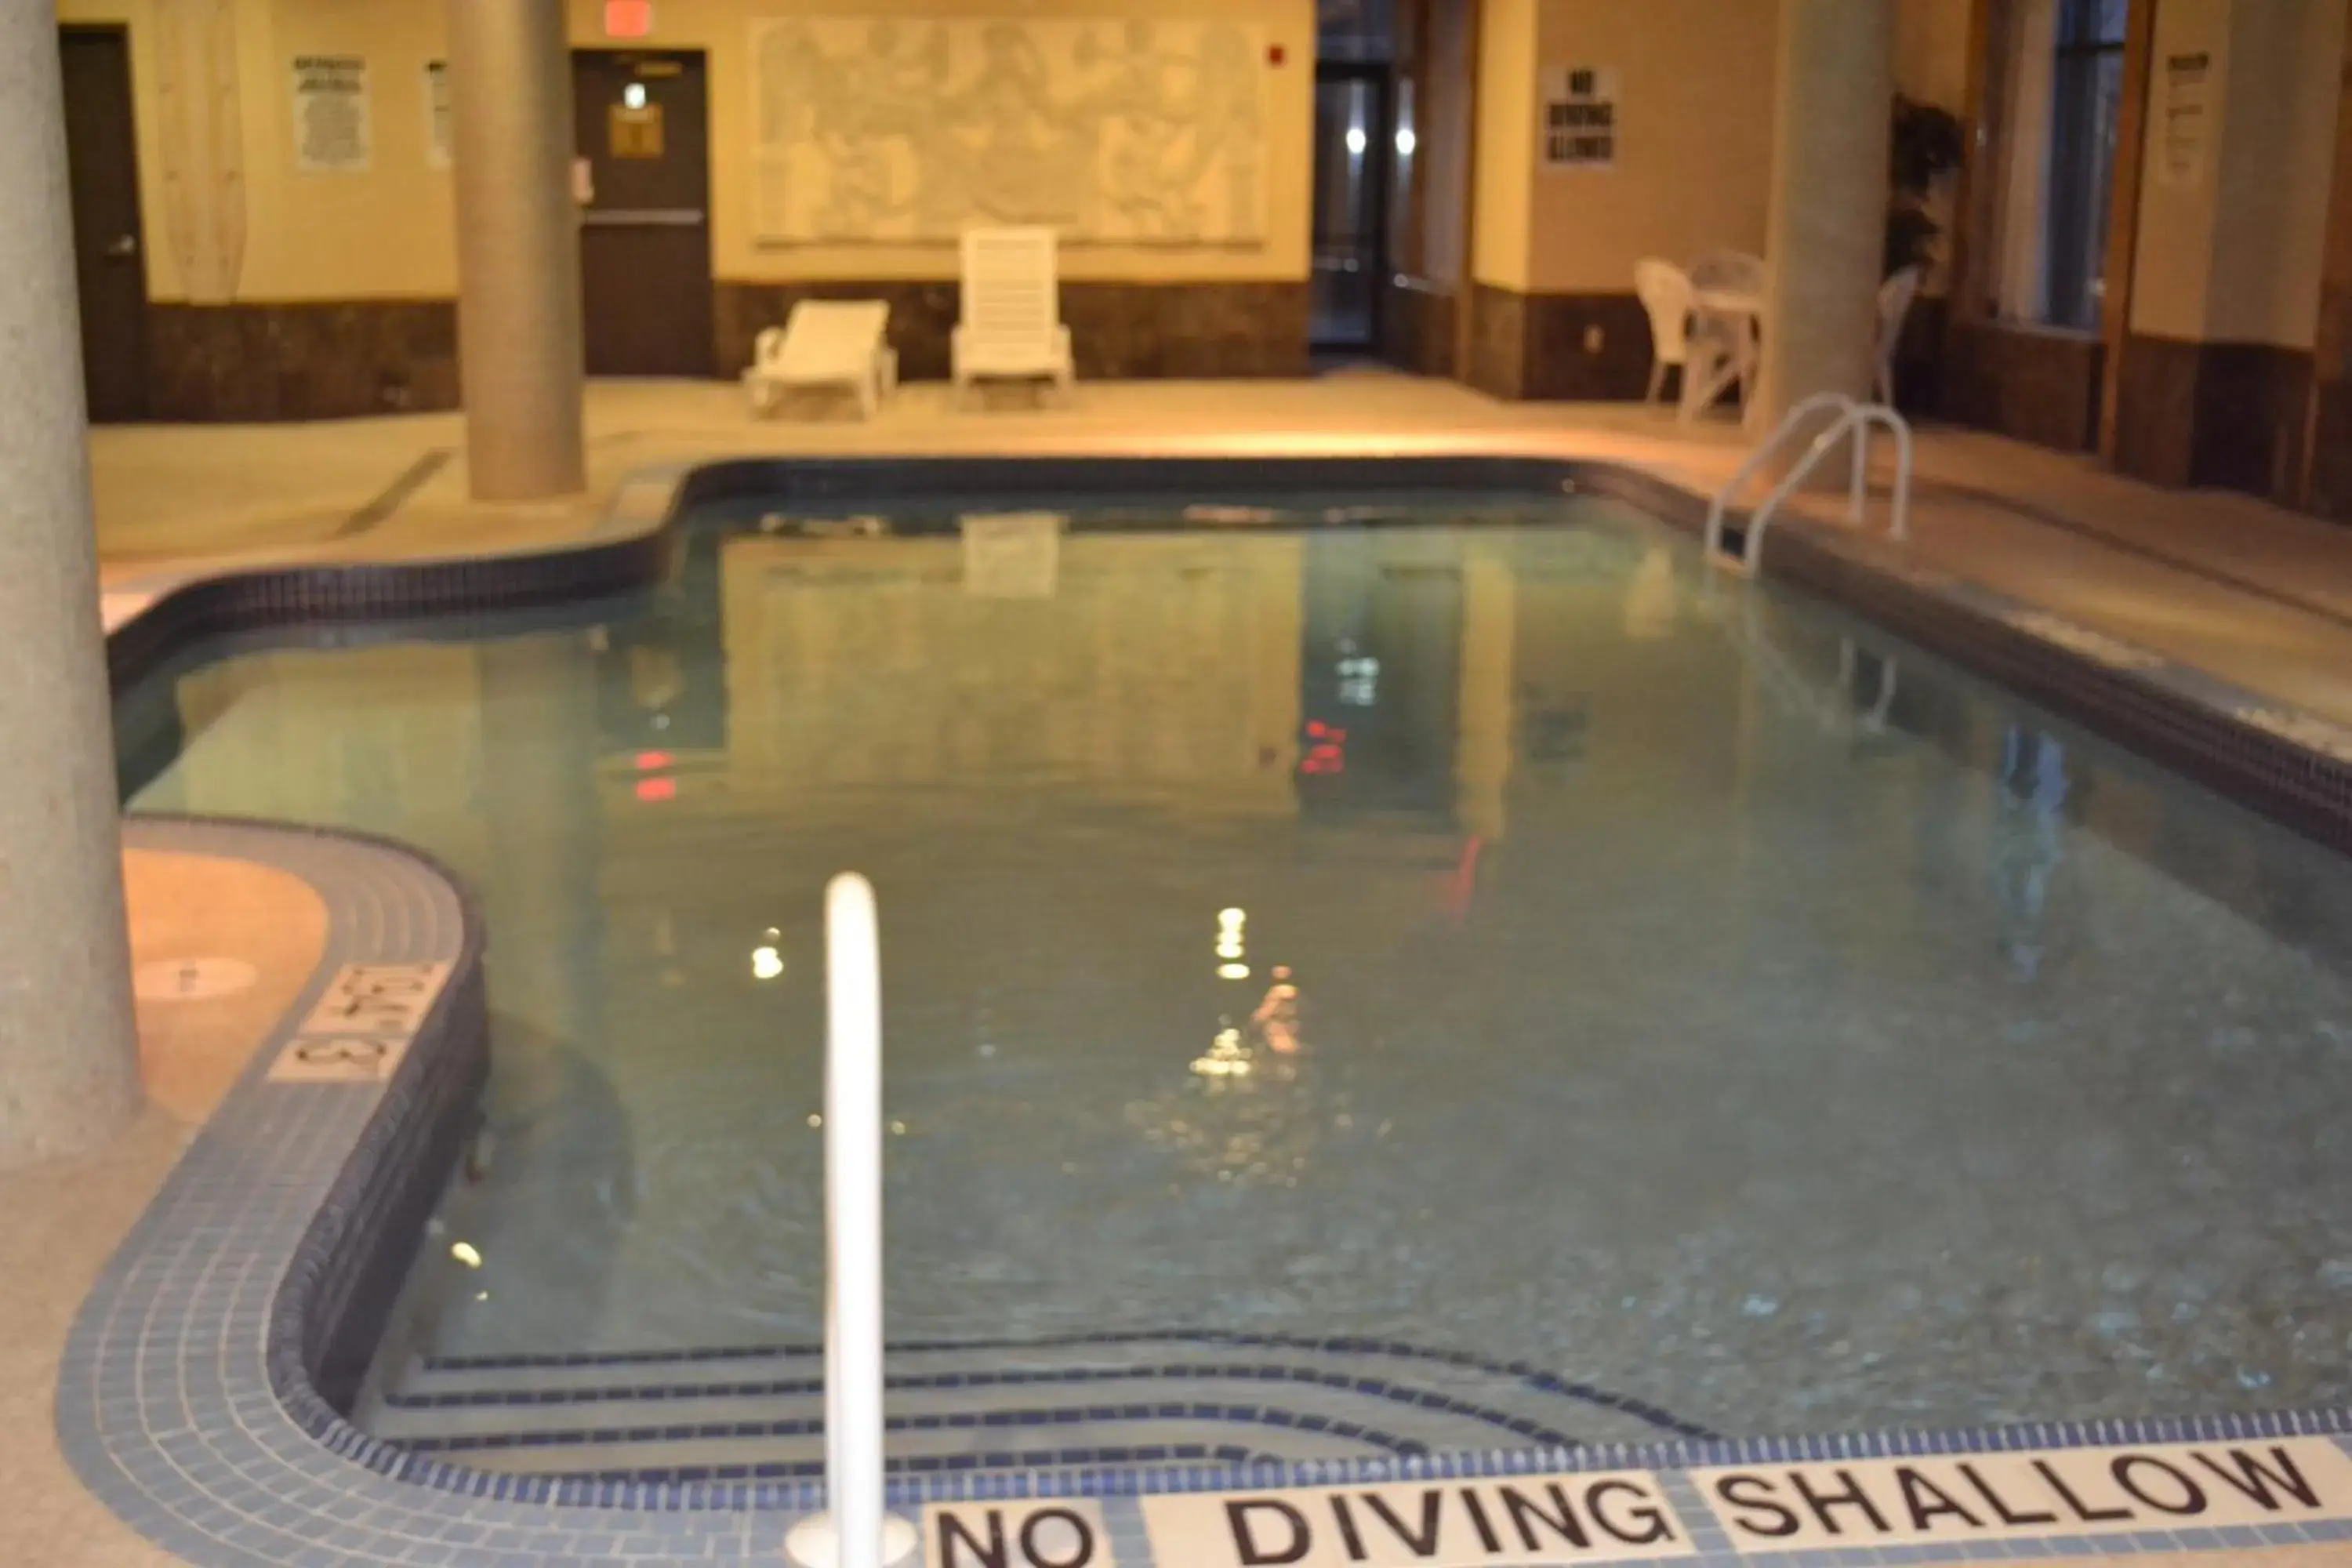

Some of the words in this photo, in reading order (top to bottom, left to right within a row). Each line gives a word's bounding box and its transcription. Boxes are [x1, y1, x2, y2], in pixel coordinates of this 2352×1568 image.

[936, 1507, 1093, 1568] NO
[1224, 1479, 1676, 1566] DIVING
[1715, 1446, 2322, 1537] SHALLOW
